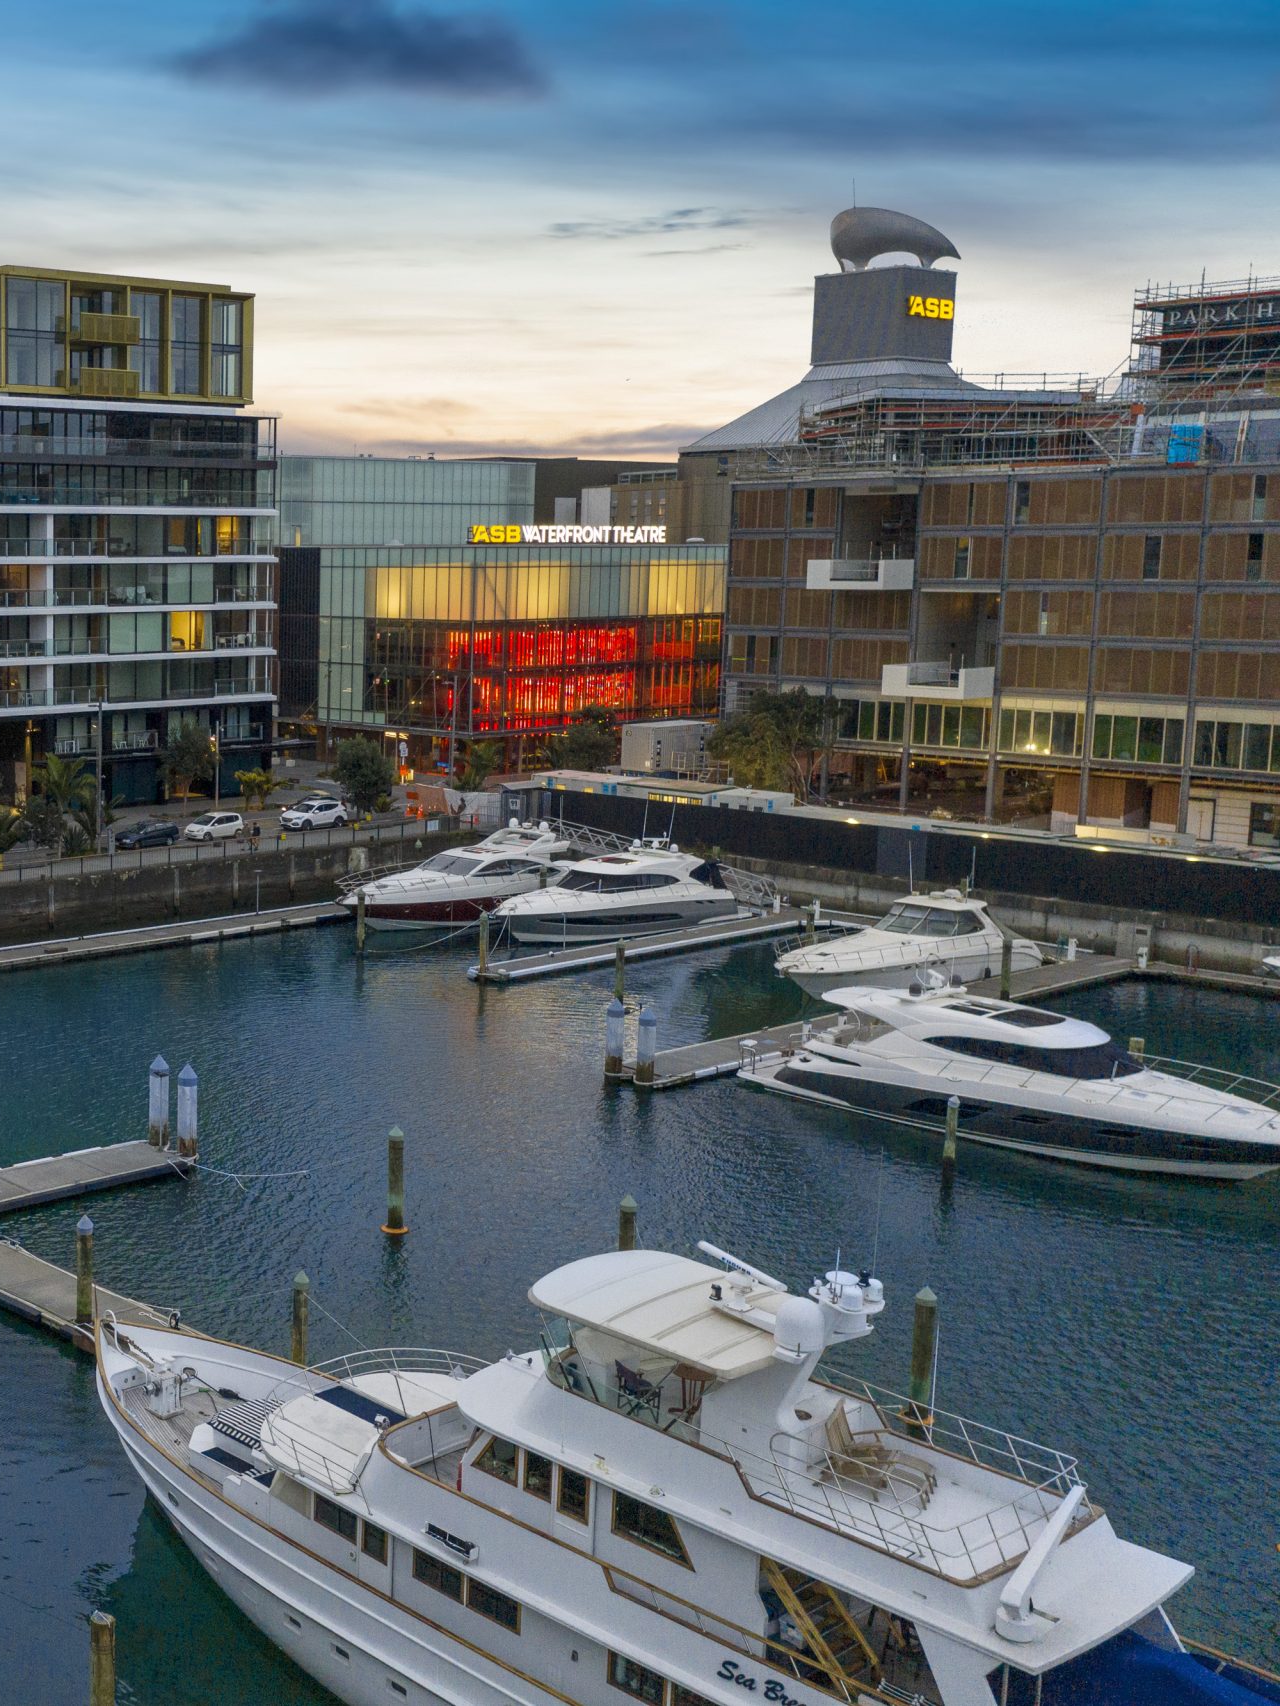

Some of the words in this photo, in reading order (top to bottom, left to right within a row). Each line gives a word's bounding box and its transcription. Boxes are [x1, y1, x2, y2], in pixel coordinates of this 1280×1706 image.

[908, 295, 954, 320] ASB
[1169, 305, 1239, 326] PARK
[471, 525, 521, 543] ASB
[522, 525, 611, 543] WATERFRONT
[612, 525, 667, 543] THEATRE
[716, 1660, 757, 1691] Sea
[763, 1678, 807, 1706] Bre
